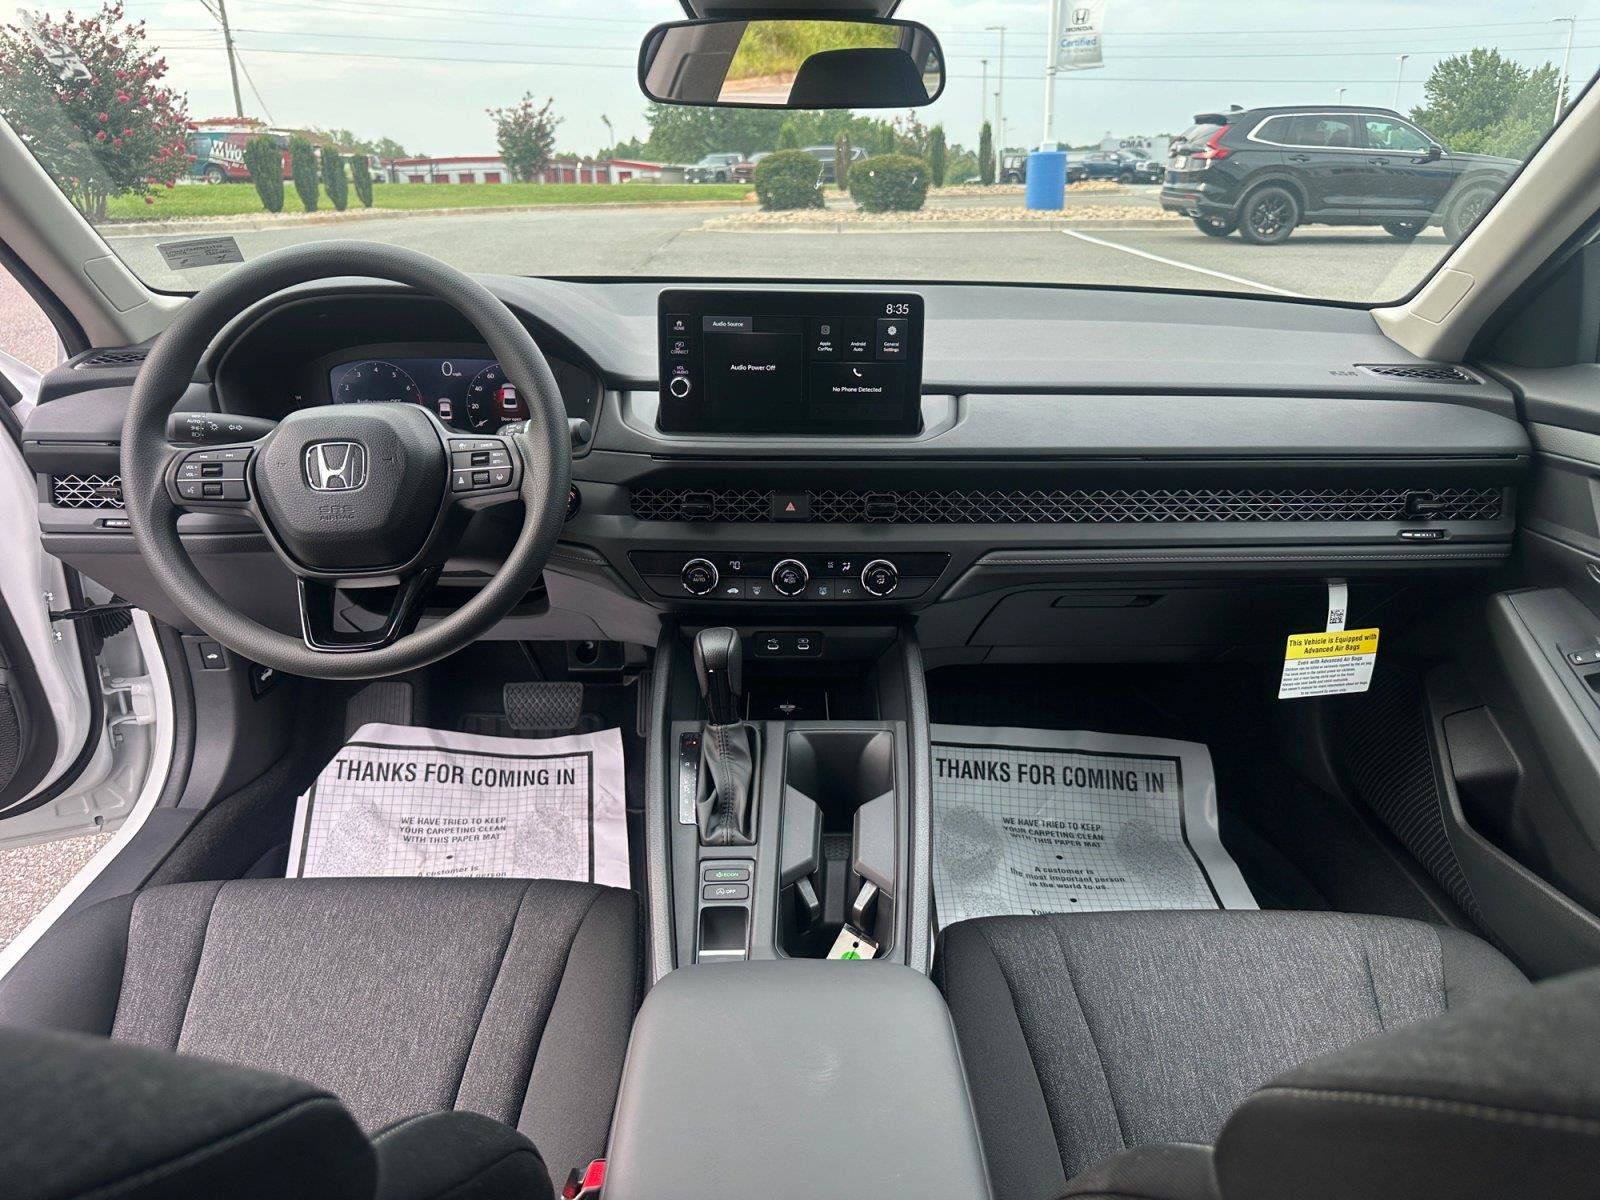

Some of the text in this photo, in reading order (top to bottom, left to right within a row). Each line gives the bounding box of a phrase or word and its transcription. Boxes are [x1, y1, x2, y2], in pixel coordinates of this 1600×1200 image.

[1060, 36, 1097, 48] Certified
[885, 303, 909, 315] 8:35
[442, 361, 453, 376] 0
[1289, 639, 1303, 647] This
[1304, 637, 1327, 646] Vehicle
[1335, 634, 1363, 645] Equipped
[1364, 633, 1377, 641] with
[1303, 643, 1361, 654] Advanced Air Bags
[335, 758, 575, 788] THANKS FOR COMING IN
[935, 757, 1164, 793] THANKS FOR COMING IN
[400, 816, 507, 826] WE HAVE TRIED TO KEEP
[1003, 816, 1101, 832] WE HAVE TRIED TO KEEP
[400, 824, 507, 835] YOUR CARPETING CLEAN
[1003, 825, 1104, 841] YOUR CARPETING CLEAN
[403, 832, 501, 844] WITH THIS PAPER MAT
[1033, 837, 1053, 845] THIS
[1054, 838, 1082, 847] PAPER
[426, 866, 468, 877] customer
[470, 864, 479, 872] is
[1010, 867, 1023, 877] the
[1025, 873, 1047, 881] most
[1049, 874, 1093, 884] important
[1043, 867, 1083, 875] customer
[1057, 882, 1082, 890] world
